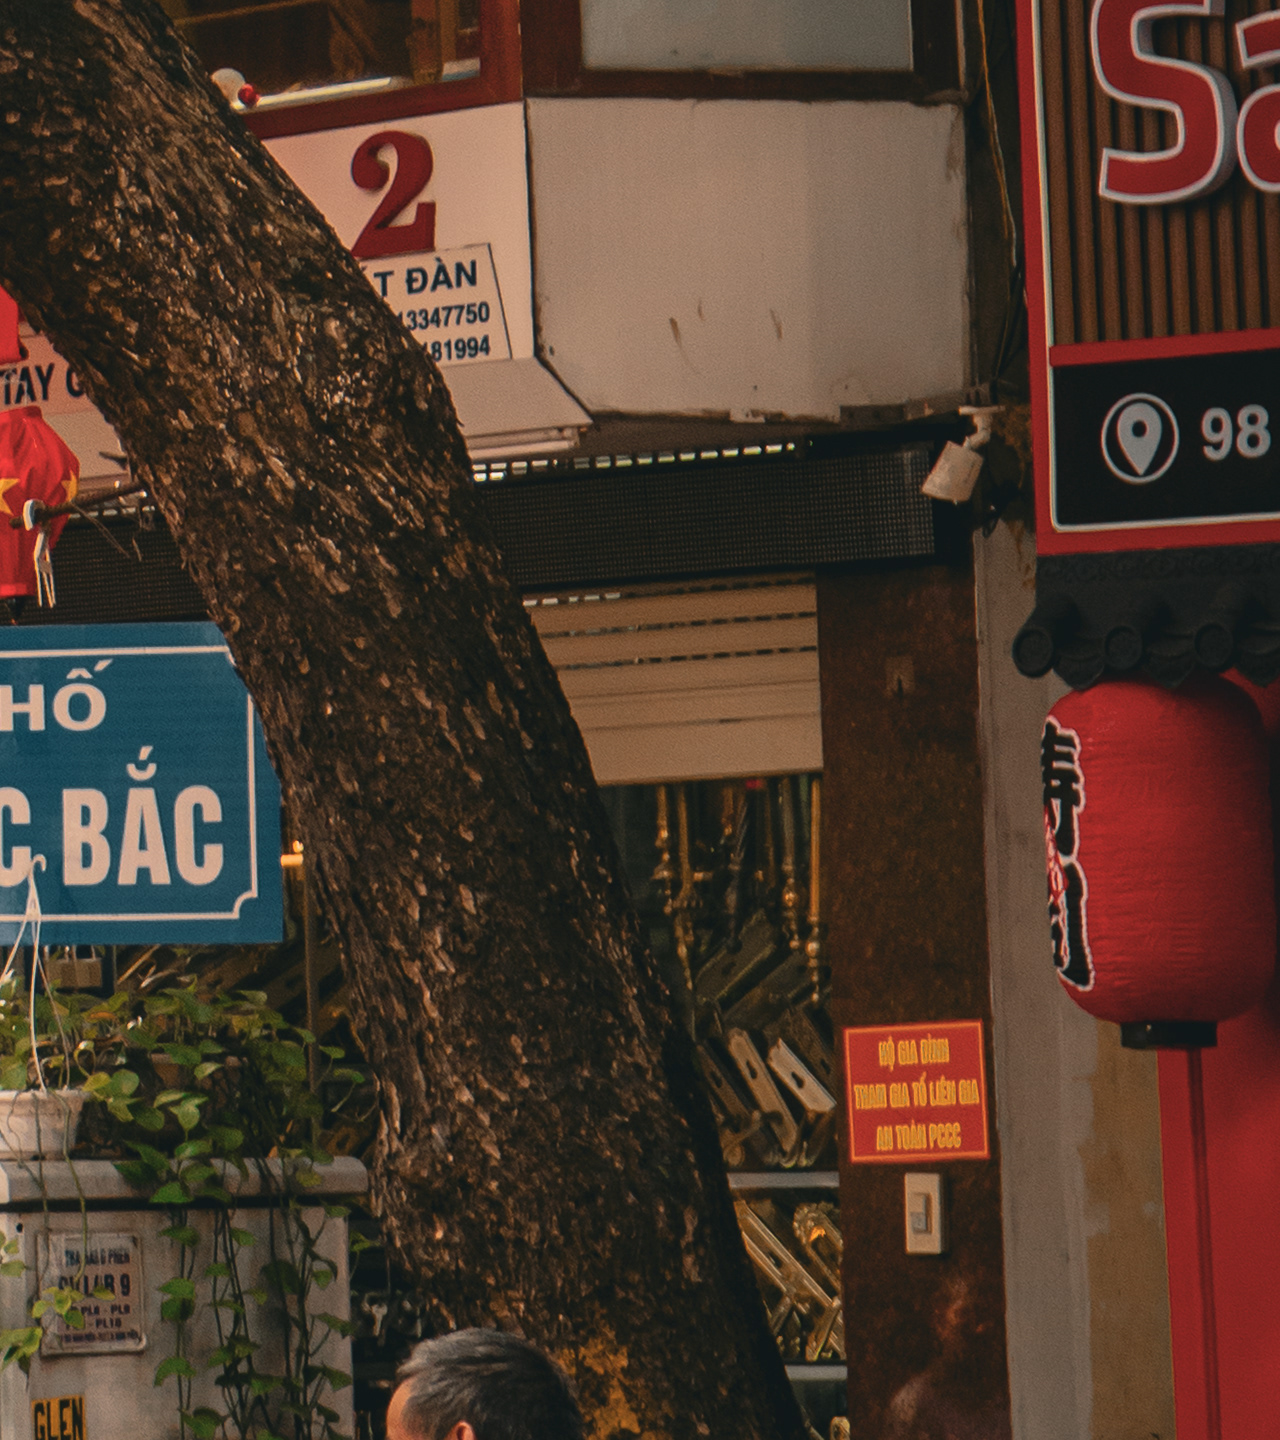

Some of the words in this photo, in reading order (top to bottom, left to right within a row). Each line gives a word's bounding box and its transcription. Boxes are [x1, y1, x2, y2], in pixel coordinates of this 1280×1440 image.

[351, 130, 436, 259] 2
[405, 257, 477, 295] ĐÀN
[422, 333, 490, 362] 81994
[1200, 404, 1271, 462] 98
[62, 746, 224, 887] BẮC
[898, 1039, 918, 1065] GIA
[890, 1082, 910, 1108] GIA
[959, 1079, 980, 1105] GIA
[876, 1125, 893, 1151] AN
[929, 1122, 962, 1149] PCCC
